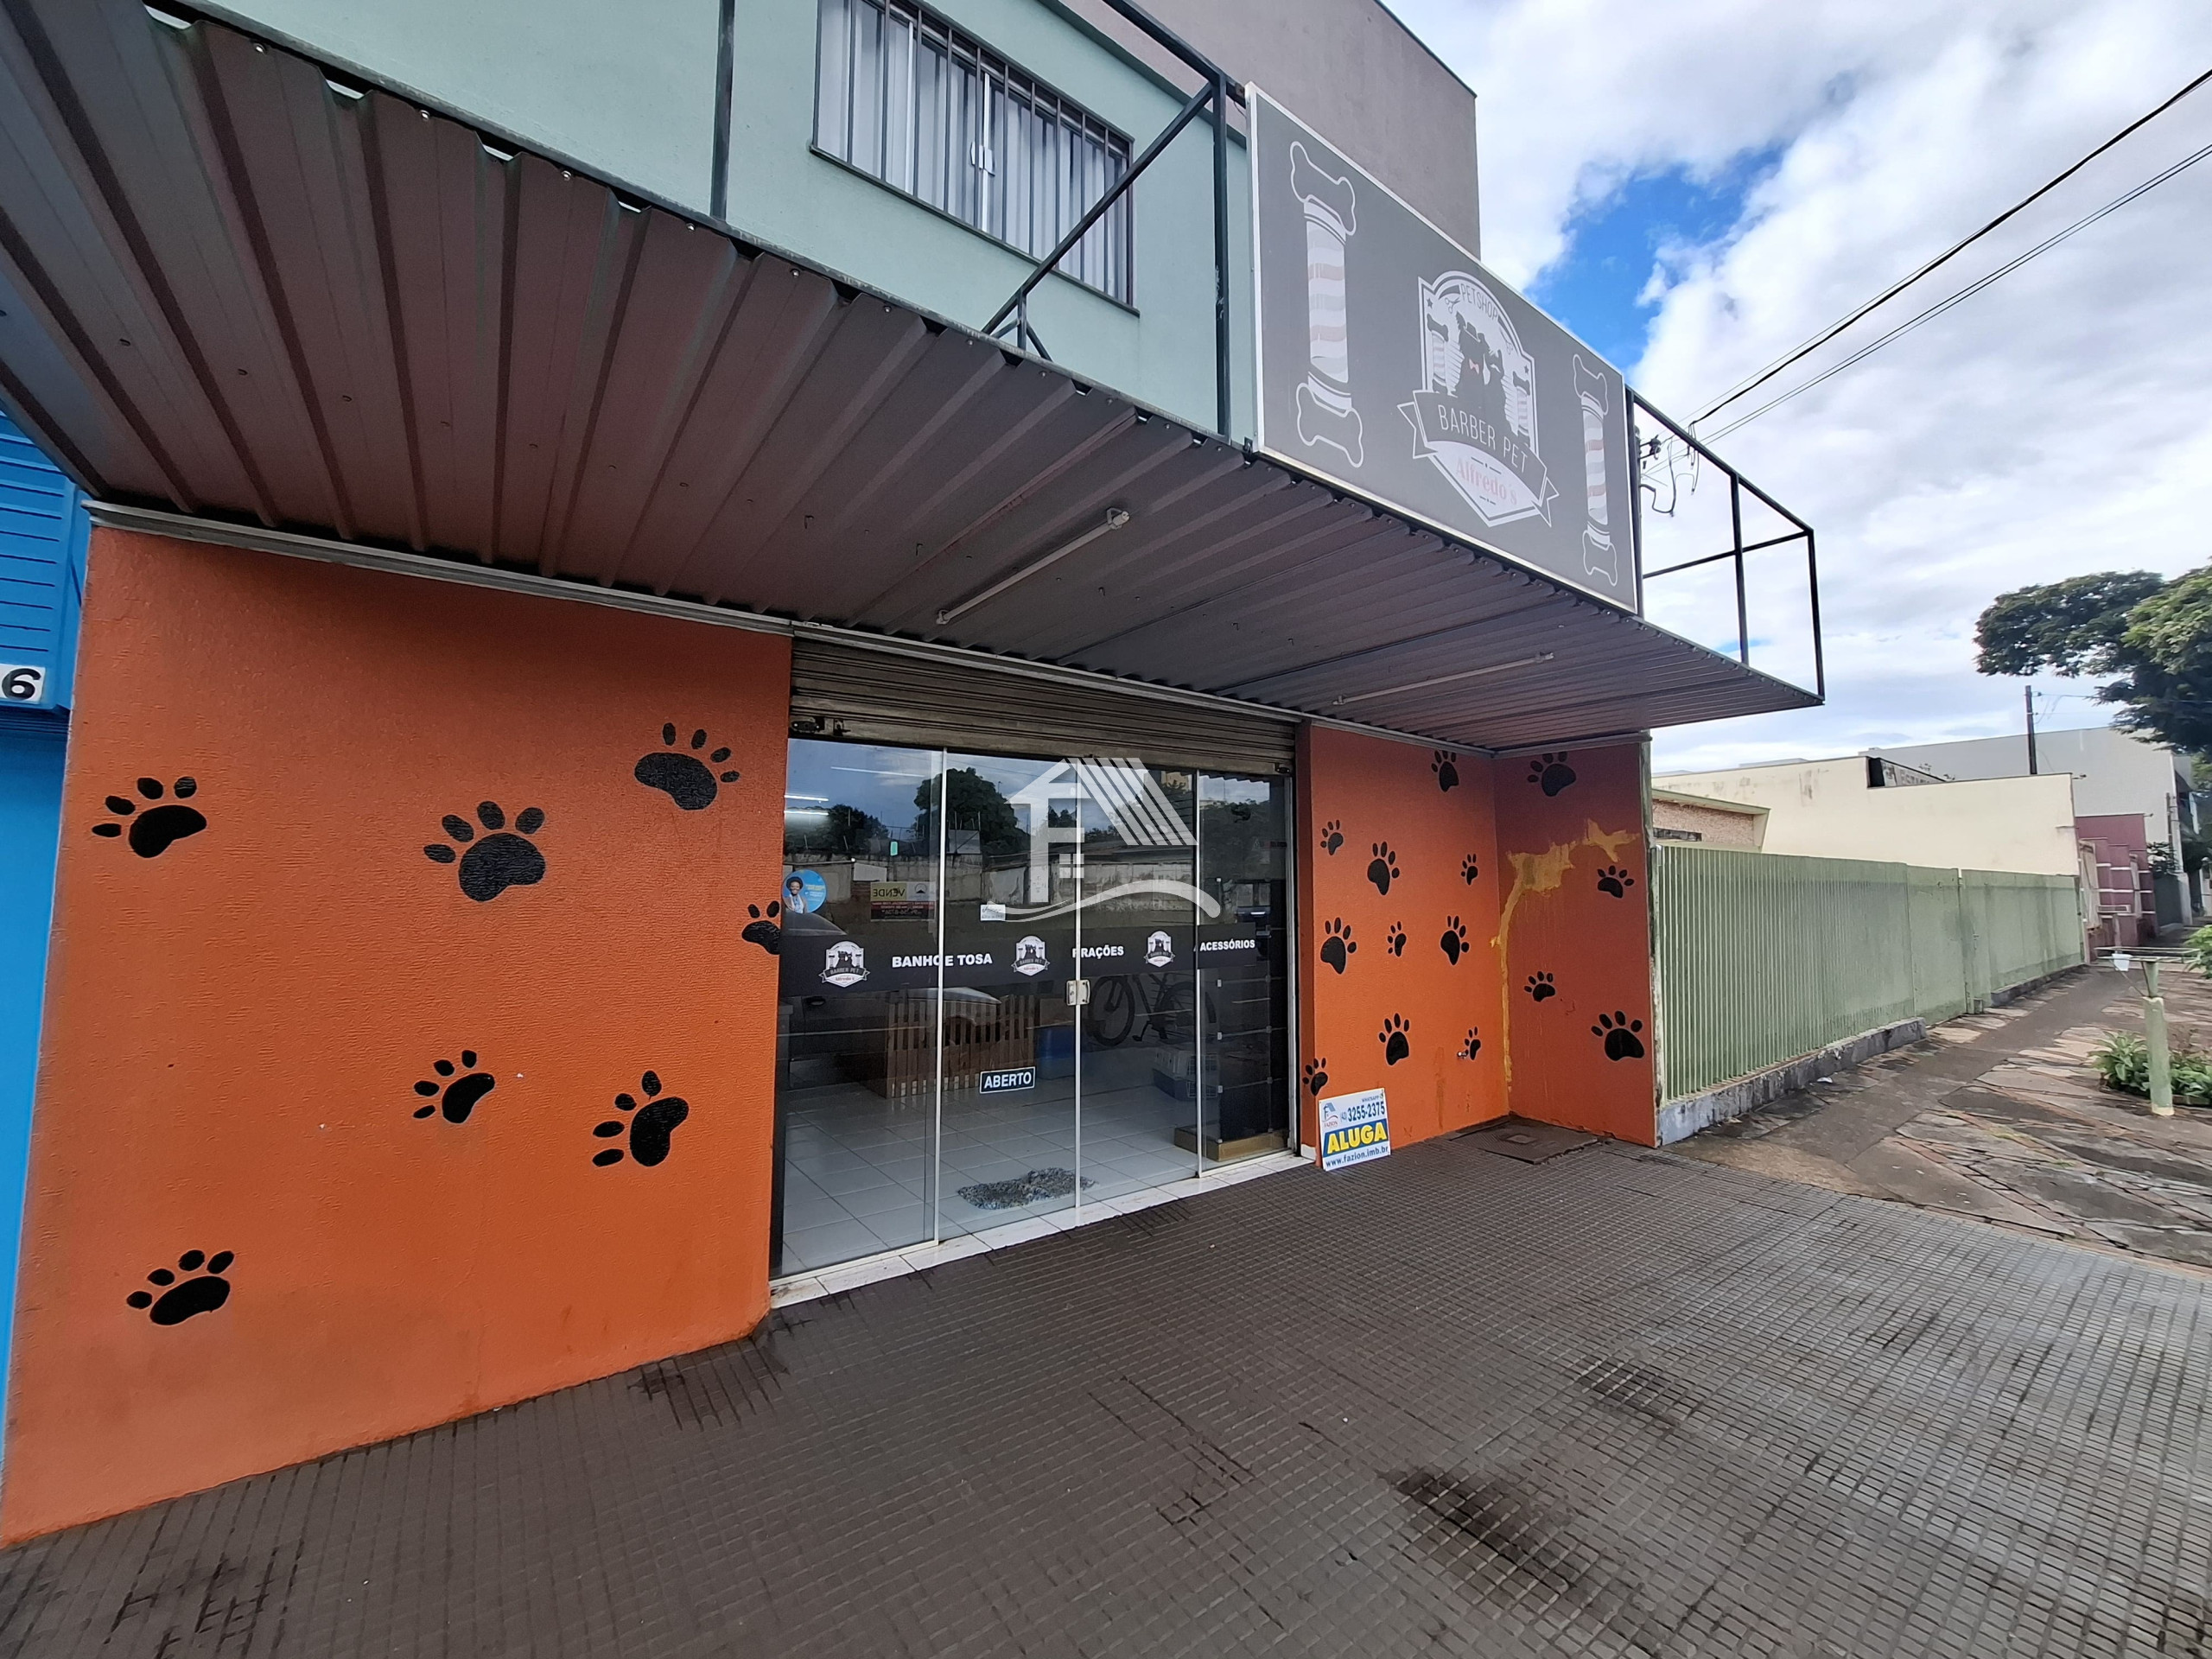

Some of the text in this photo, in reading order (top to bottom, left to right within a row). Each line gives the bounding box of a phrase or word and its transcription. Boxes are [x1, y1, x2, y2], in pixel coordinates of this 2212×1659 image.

[1437, 404, 1528, 474] BARBER PET
[1199, 938, 1255, 952] ACESSÓRIOS
[892, 953, 993, 968] BANHO E TOSA
[983, 1071, 1032, 1089] ABERTO
[1347, 1101, 1386, 1122] 3255-2375
[1327, 1122, 1388, 1154] ALUGA
[1325, 1146, 1389, 1168] www.fazion.imb.br
